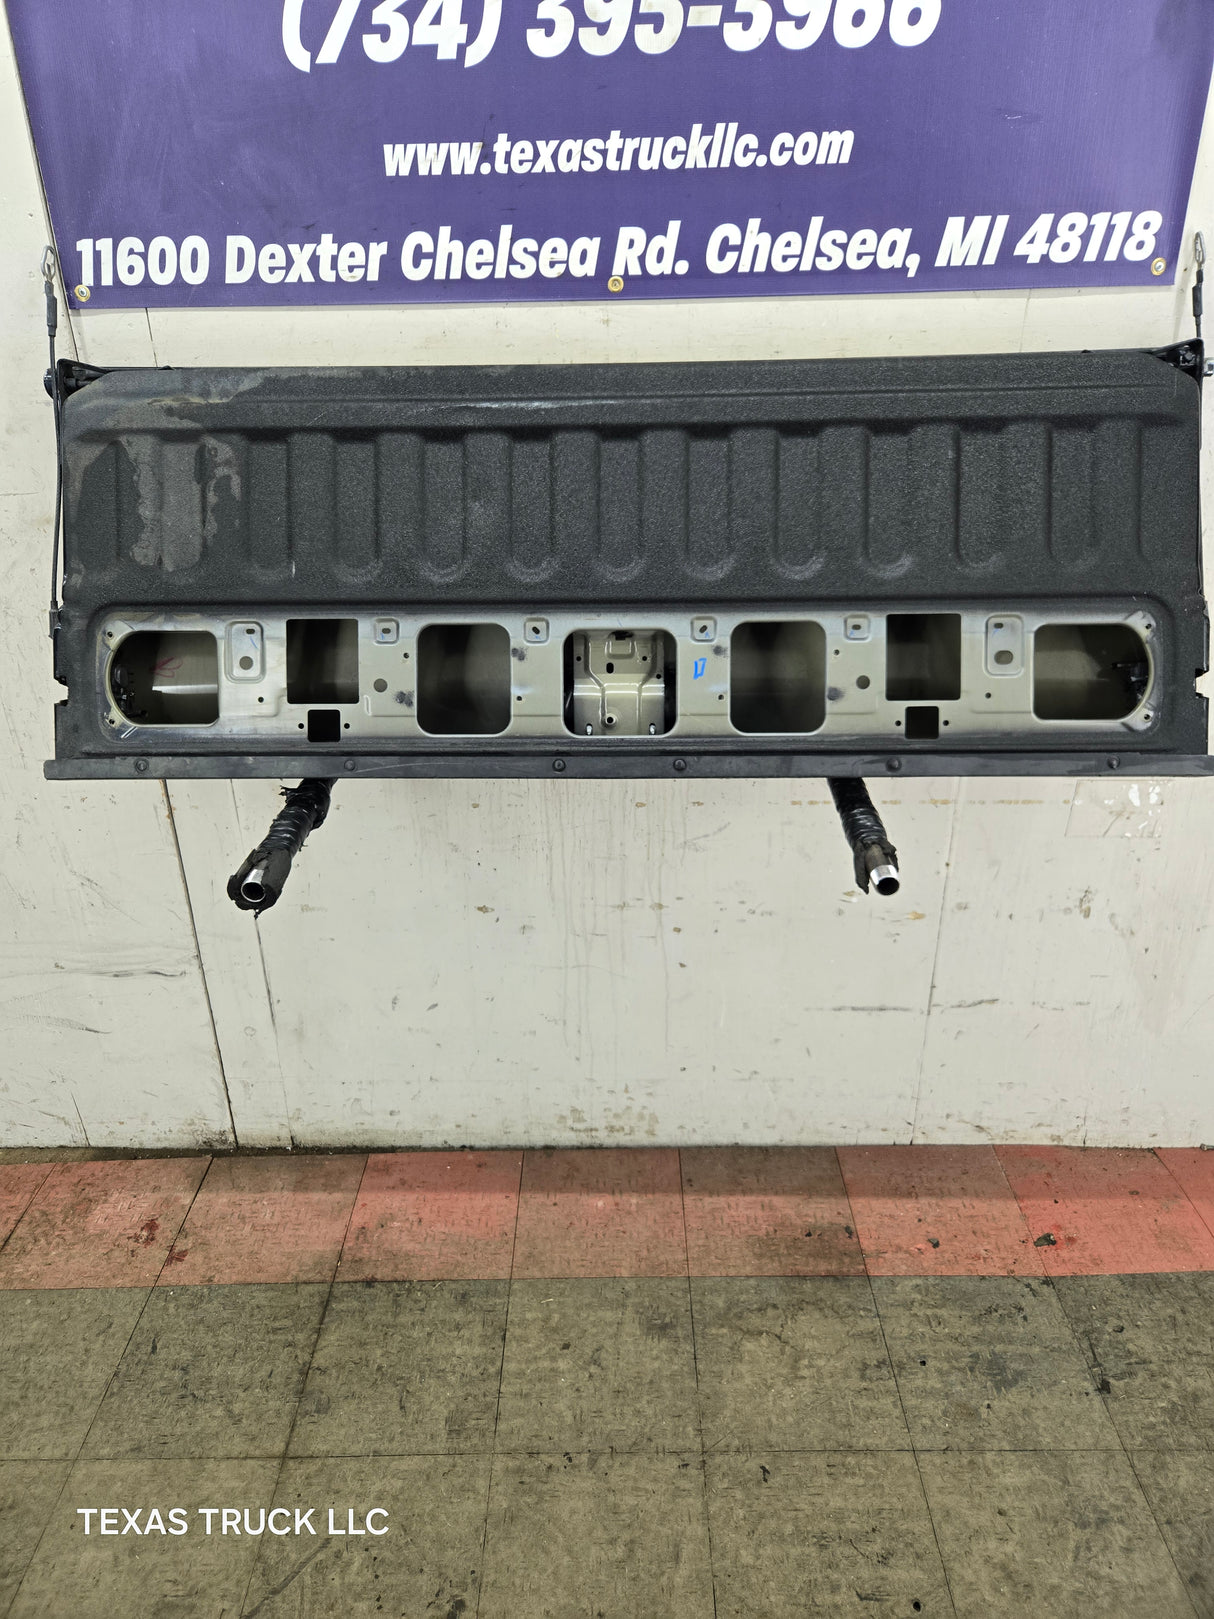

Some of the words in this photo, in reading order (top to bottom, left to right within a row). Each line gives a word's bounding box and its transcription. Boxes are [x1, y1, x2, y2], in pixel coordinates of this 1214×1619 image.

[282, 0, 502, 73] (734)
[383, 123, 855, 177] www.texastruckllc.com
[76, 235, 210, 287] 11600
[224, 234, 389, 284] Dexter
[401, 225, 601, 281] Chelsea
[611, 219, 690, 277] Rd.
[705, 216, 921, 278] Chelsea,
[935, 215, 1009, 267] MI
[1013, 210, 1163, 264] 48118
